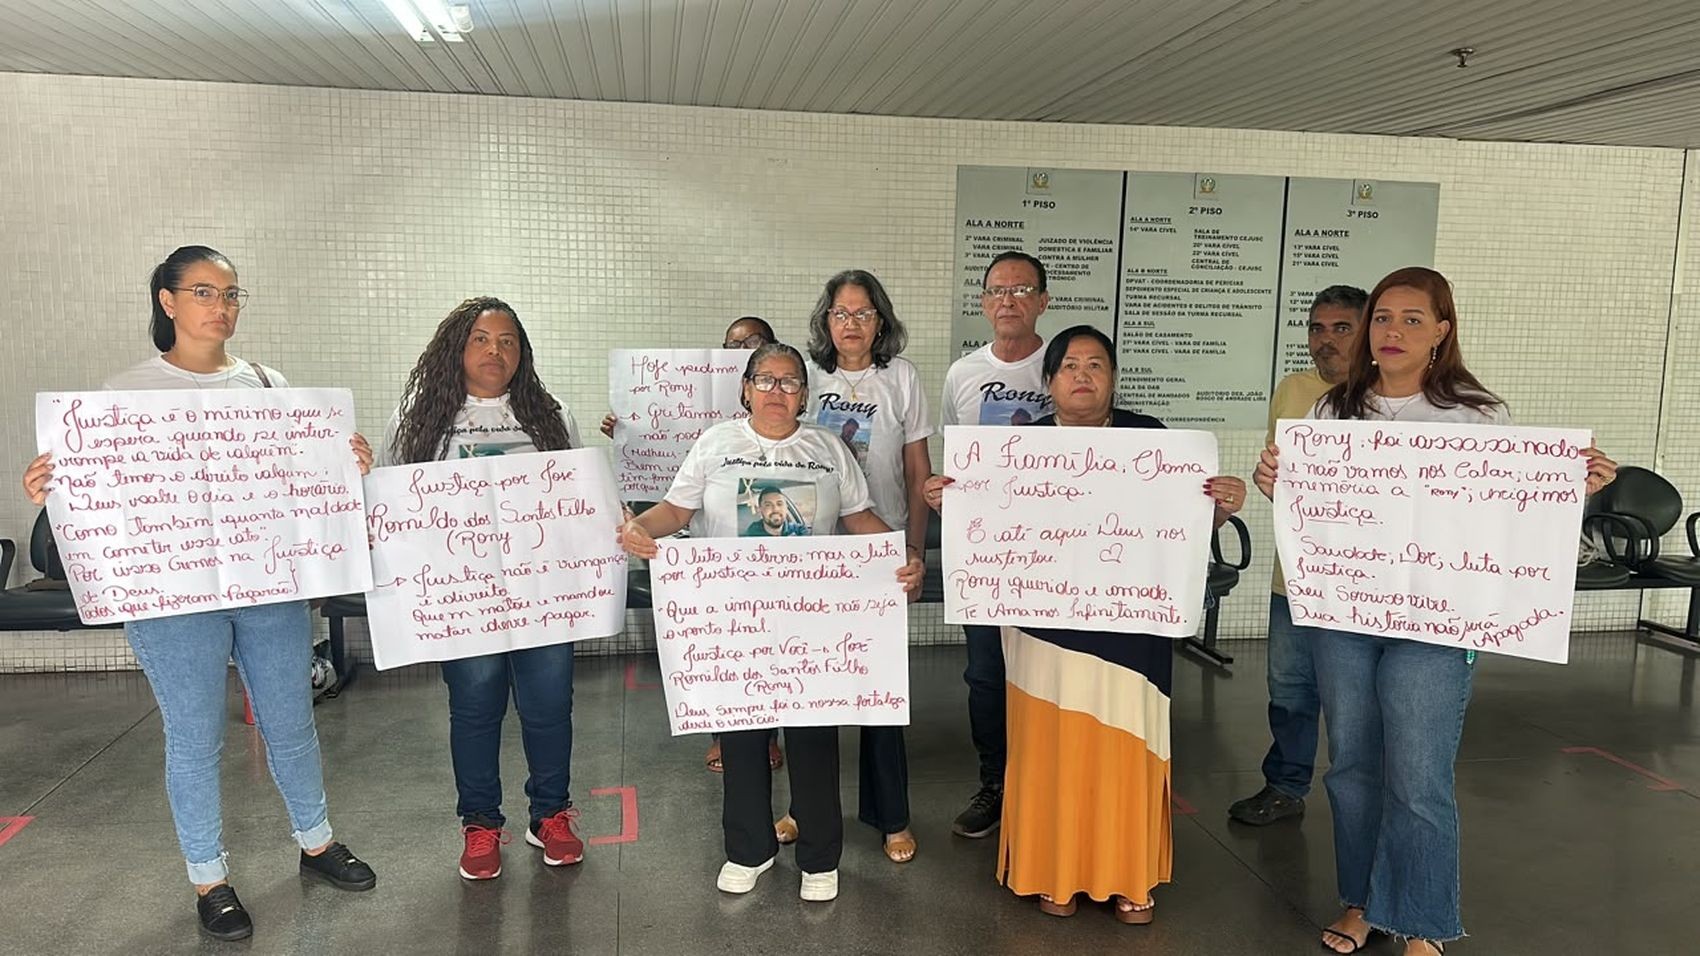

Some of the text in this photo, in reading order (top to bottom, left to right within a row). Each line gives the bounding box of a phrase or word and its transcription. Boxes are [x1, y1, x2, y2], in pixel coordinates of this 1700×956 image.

[1033, 200, 1056, 209] PISO
[1200, 207, 1222, 215] PISO
[1358, 211, 1379, 219] PISO
[994, 220, 1024, 229] NORTE
[1294, 229, 1311, 237] ALA
[979, 381, 1053, 408] Rony
[818, 392, 879, 418] Rony
